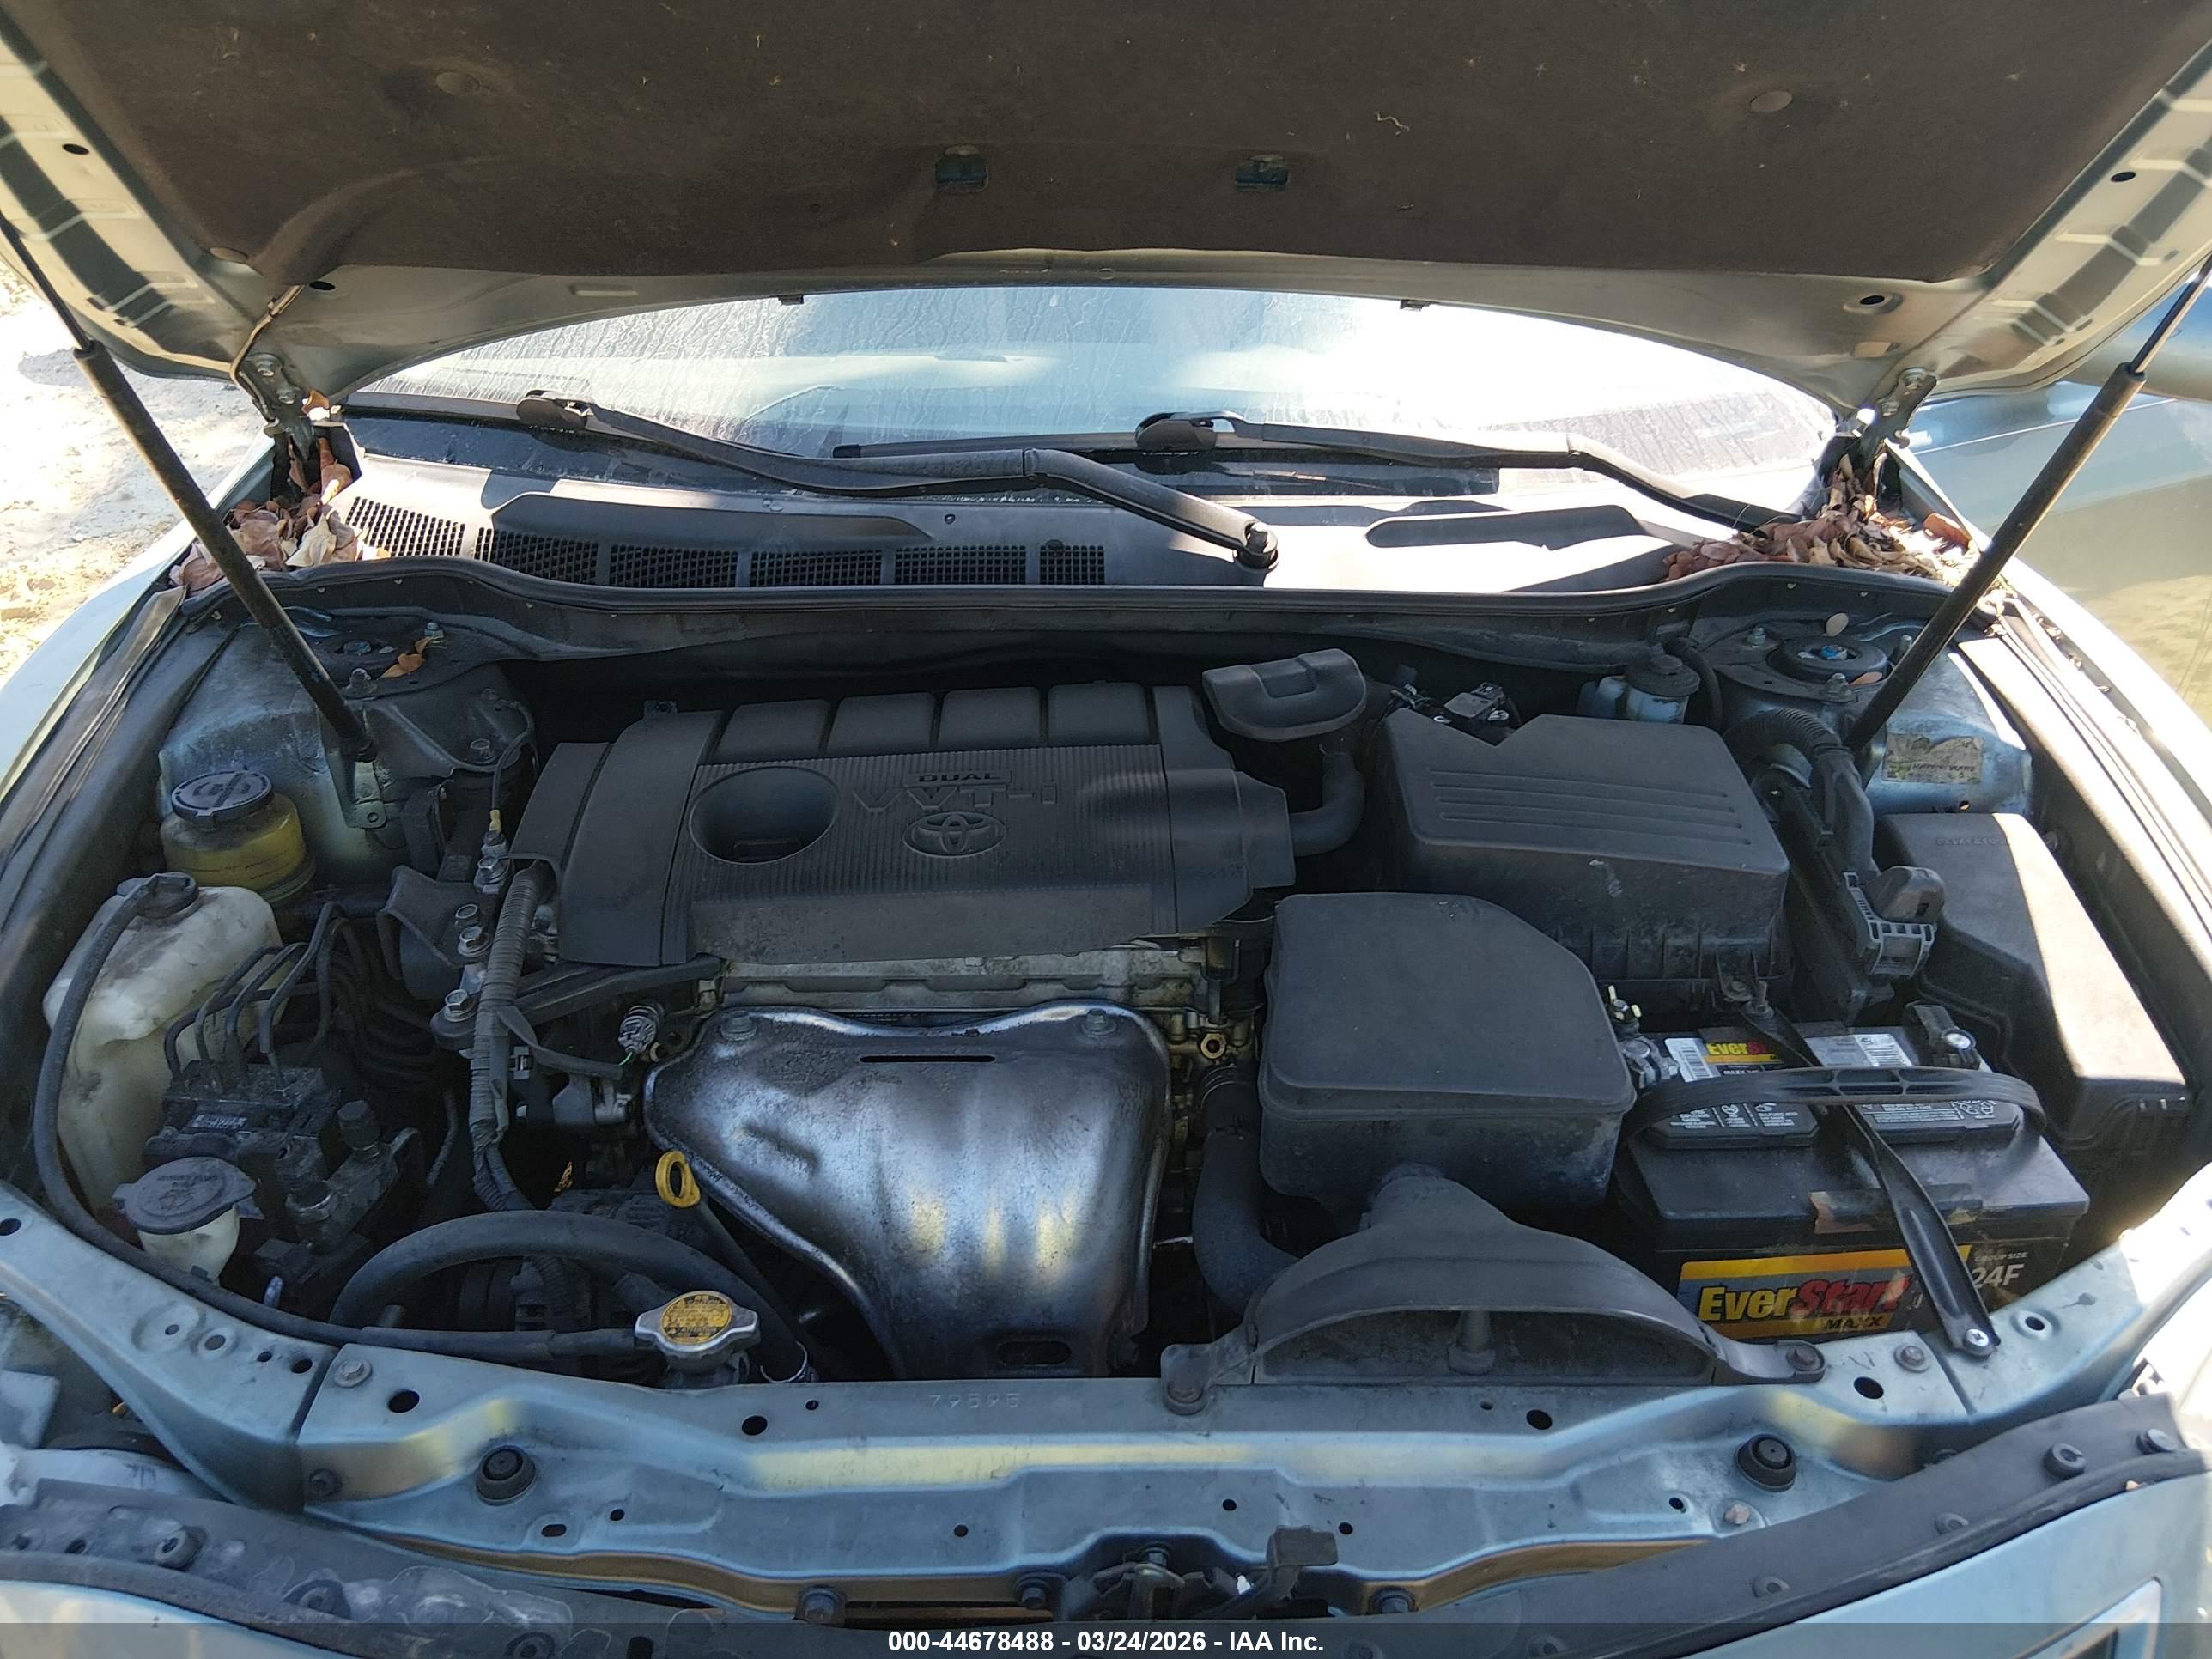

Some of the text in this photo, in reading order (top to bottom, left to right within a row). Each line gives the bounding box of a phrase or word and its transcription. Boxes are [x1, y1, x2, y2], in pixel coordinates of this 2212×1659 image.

[919, 774, 1000, 783] DUAL
[1971, 1263, 2025, 1289] 24F
[1698, 1274, 1914, 1322] EverStart
